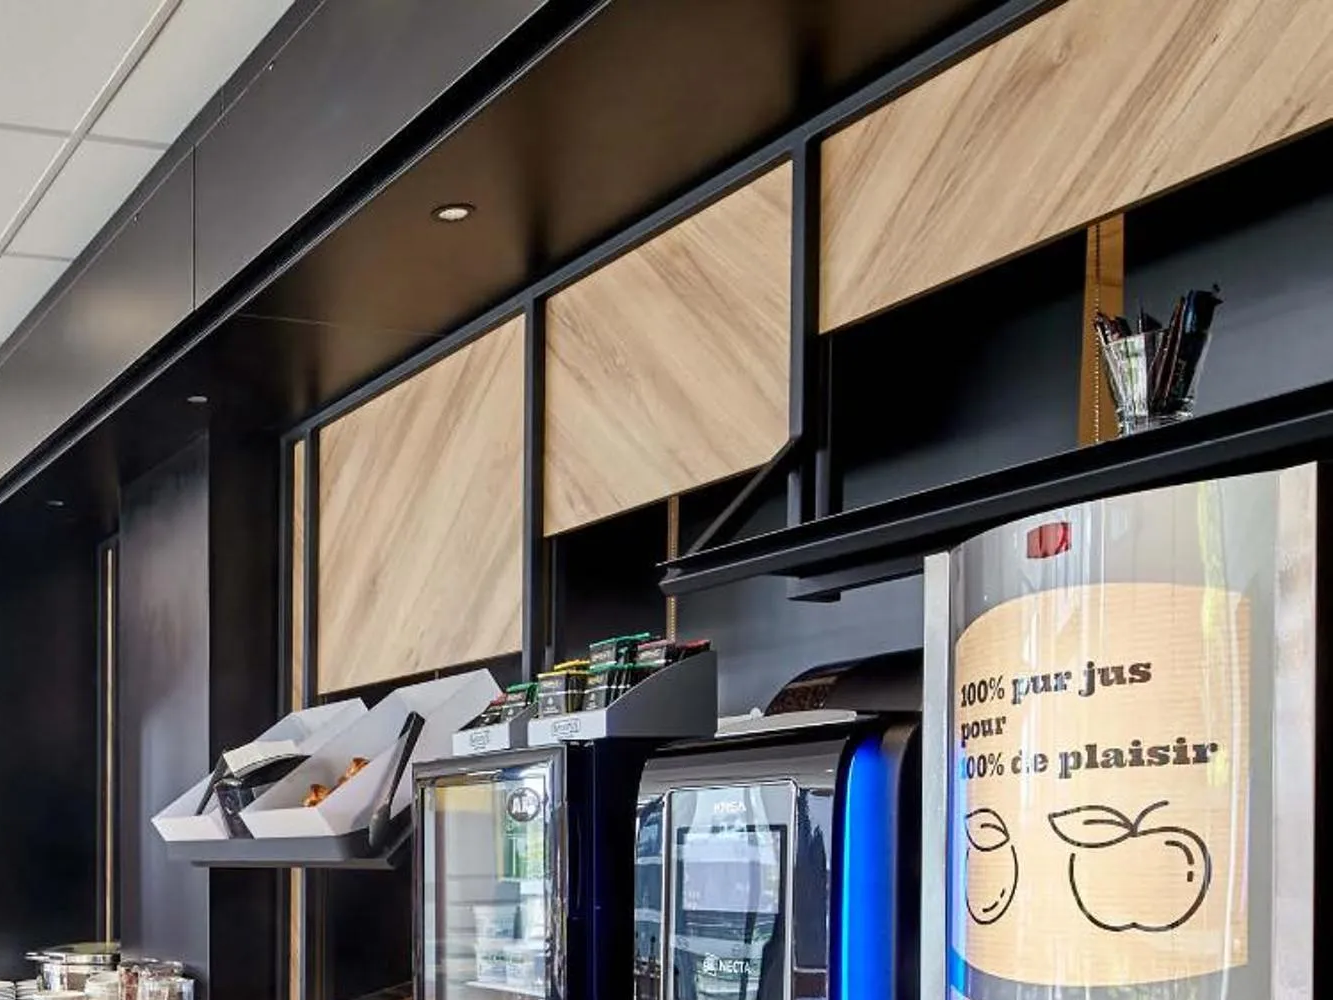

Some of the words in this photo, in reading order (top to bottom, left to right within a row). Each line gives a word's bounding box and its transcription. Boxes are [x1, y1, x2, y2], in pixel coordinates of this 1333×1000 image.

[960, 675, 1005, 708] 100%
[1011, 671, 1072, 705] pur
[1078, 660, 1153, 697] jus
[961, 716, 1007, 748] pour
[1058, 737, 1220, 779] plaisir
[719, 959, 752, 974] NECTA
